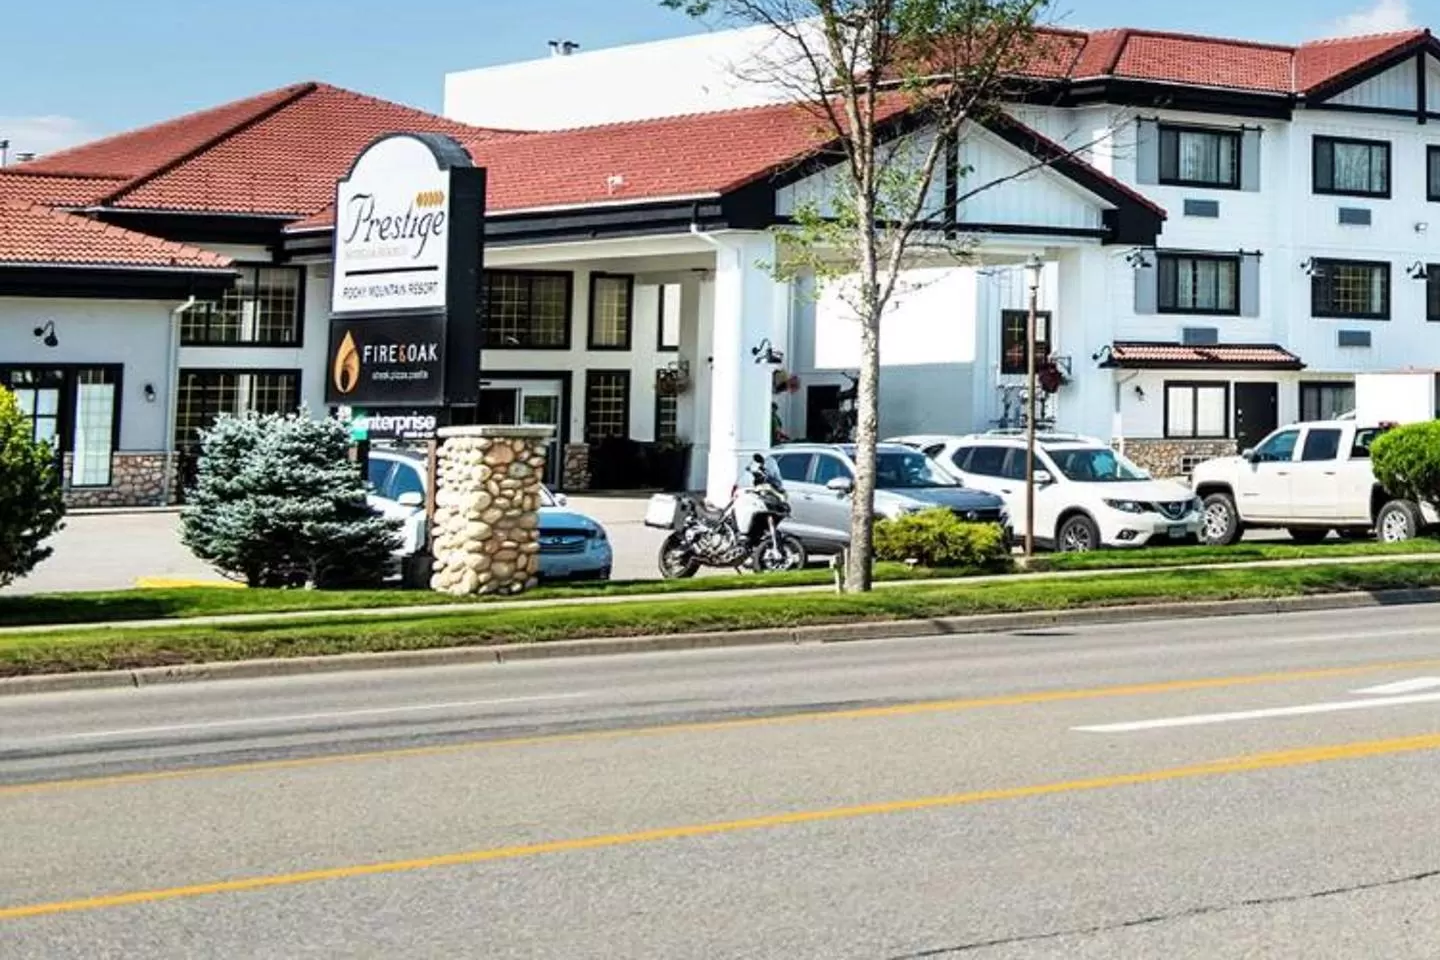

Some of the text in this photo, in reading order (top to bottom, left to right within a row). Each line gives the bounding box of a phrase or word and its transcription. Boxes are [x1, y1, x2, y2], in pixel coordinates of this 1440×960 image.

[343, 193, 444, 259] Prestige
[368, 283, 406, 298] MOUNTAIN
[408, 281, 438, 295] RESORT
